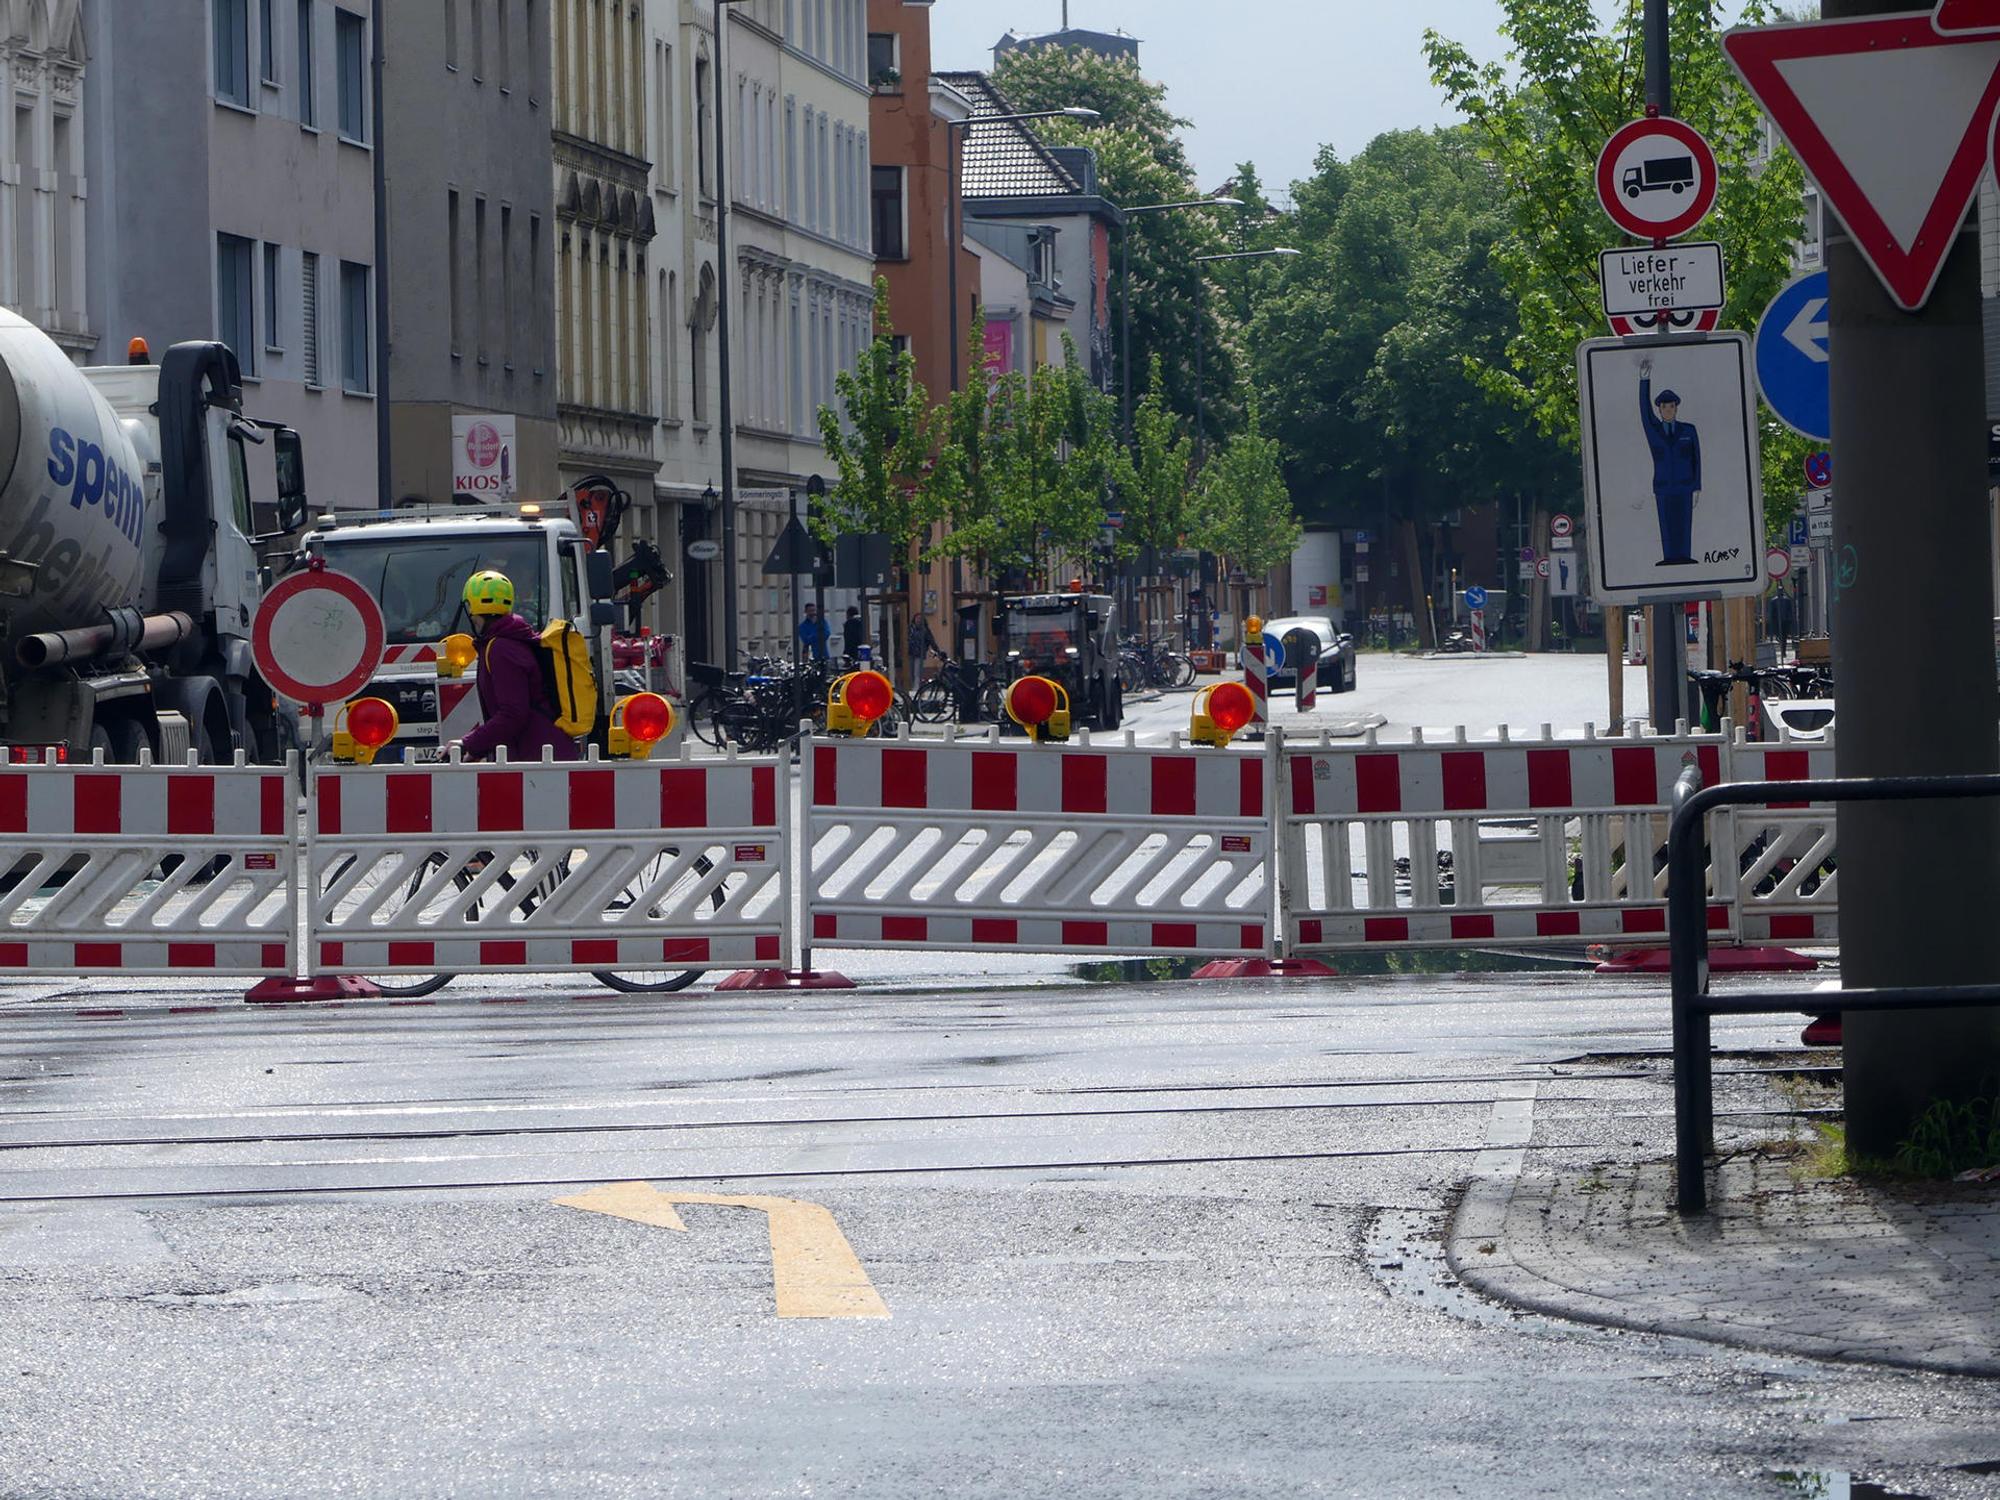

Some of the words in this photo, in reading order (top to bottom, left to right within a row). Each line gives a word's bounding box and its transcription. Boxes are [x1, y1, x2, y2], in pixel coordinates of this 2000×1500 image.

[1628, 273, 1686, 294] verkehr
[1648, 293, 1675, 307] frei
[400, 690, 436, 703] MA
